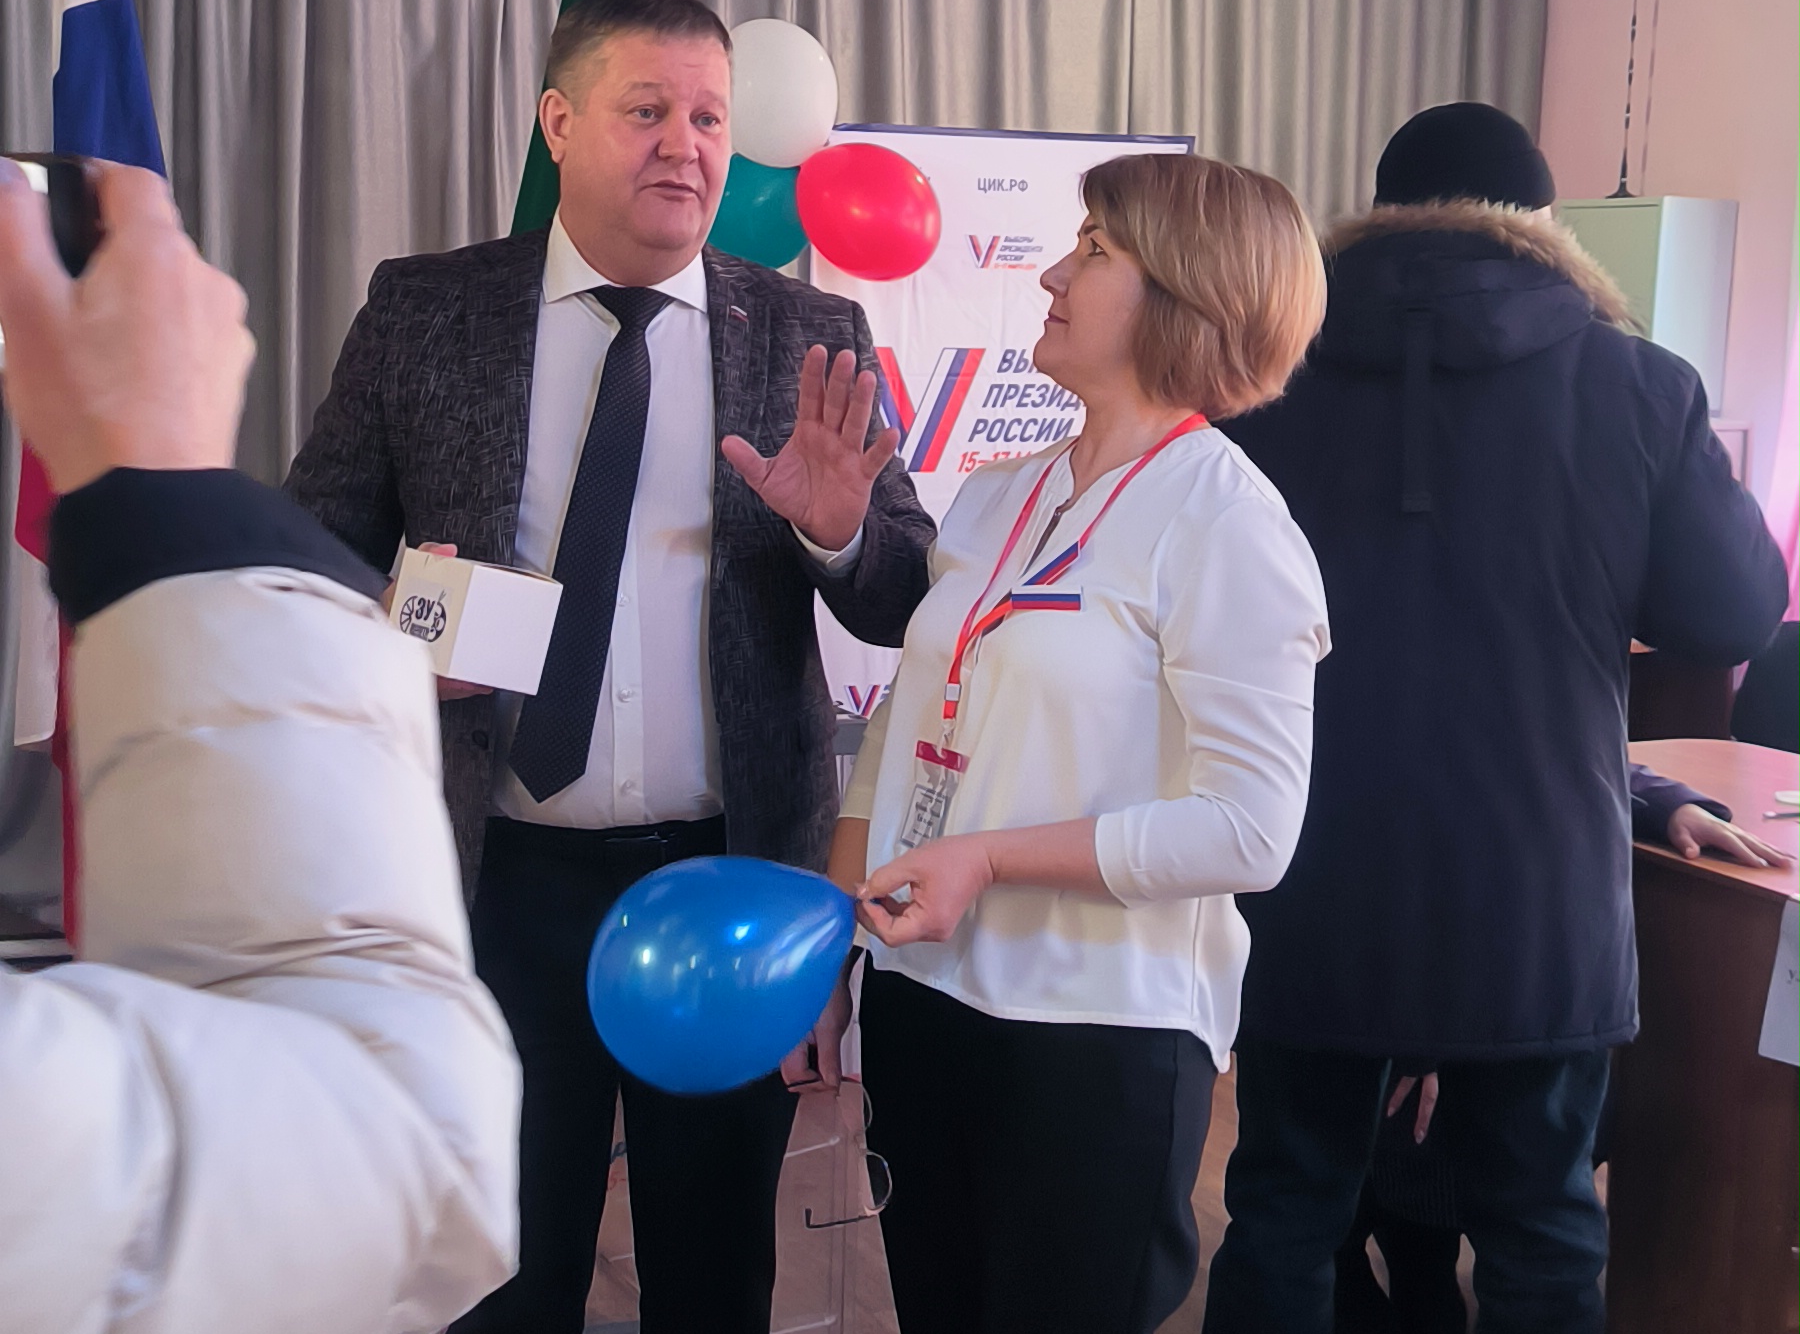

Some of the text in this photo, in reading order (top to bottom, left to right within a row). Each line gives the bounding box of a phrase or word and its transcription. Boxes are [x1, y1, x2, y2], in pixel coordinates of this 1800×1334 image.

[977, 178, 1028, 193] ЦИК.РФ
[982, 383, 1087, 412] ПРЕЗИД
[967, 417, 1075, 443] РОССИИ
